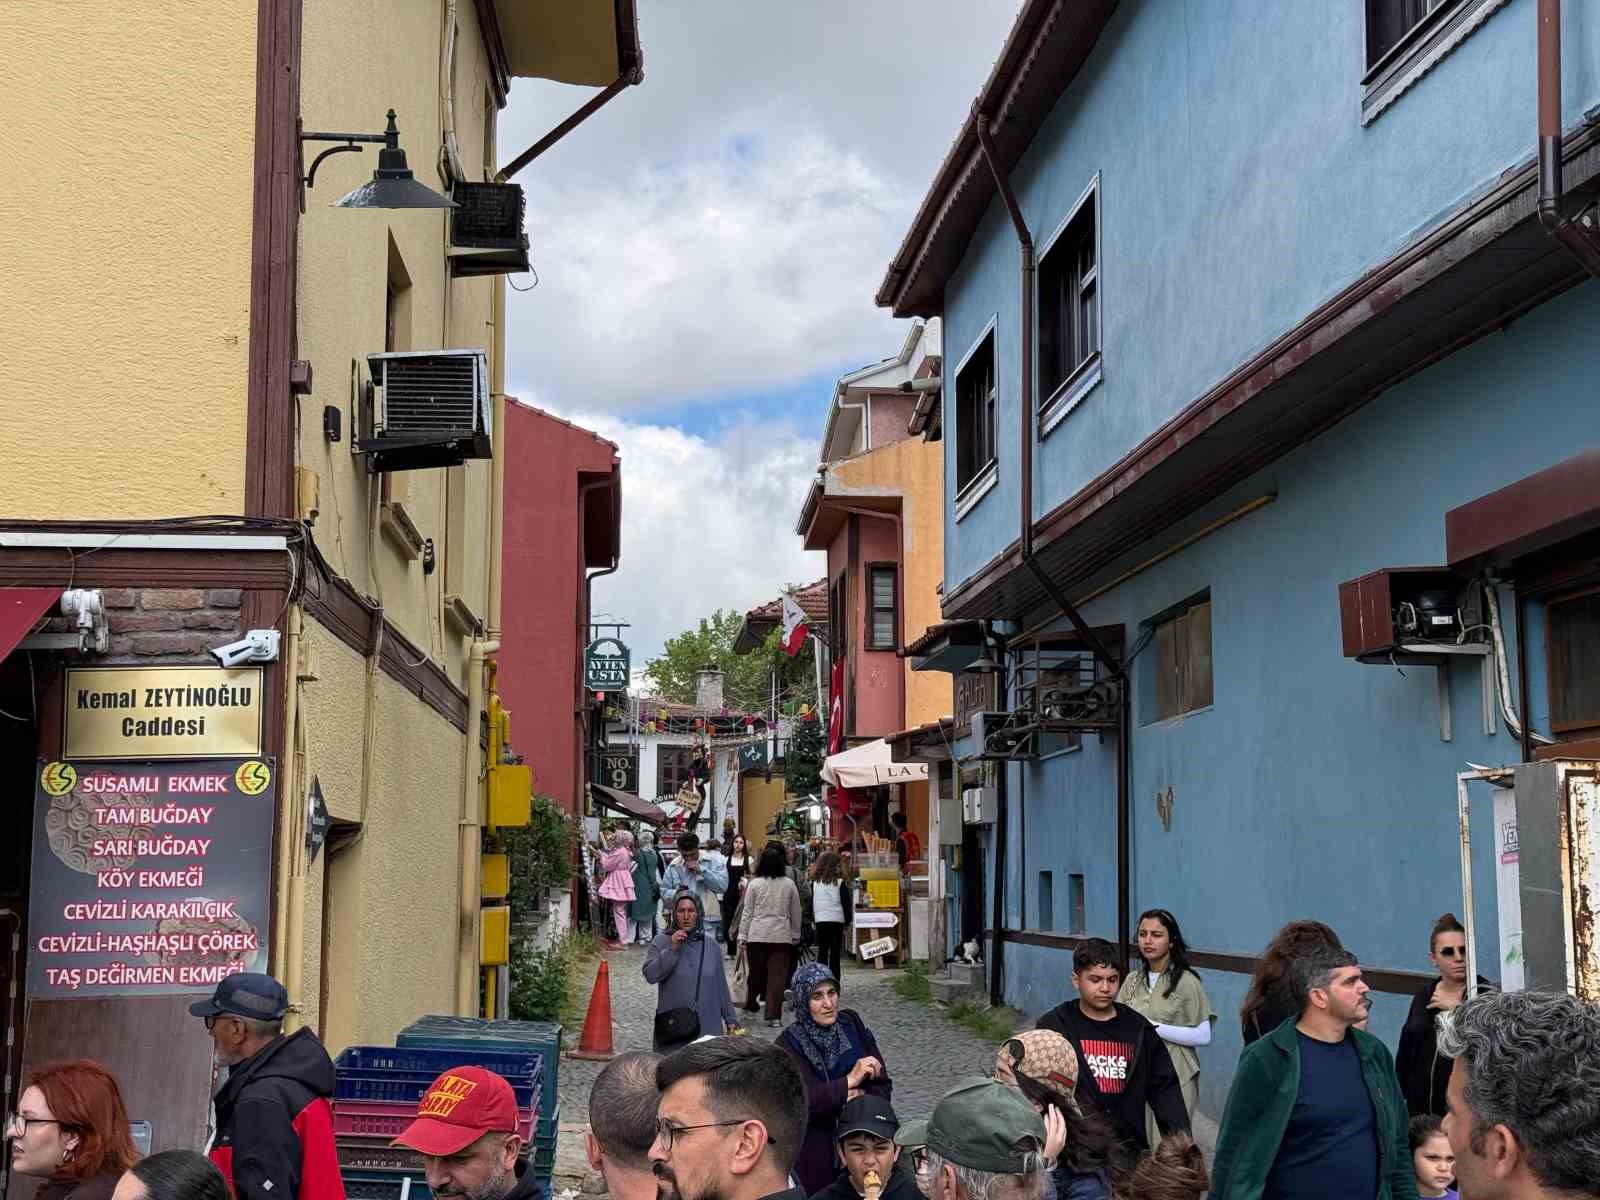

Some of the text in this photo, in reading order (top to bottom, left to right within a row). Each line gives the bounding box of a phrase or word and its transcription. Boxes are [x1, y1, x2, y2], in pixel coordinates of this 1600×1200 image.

[589, 670, 626, 681] USTA
[77, 684, 252, 709] Kemal ZEYTİNOĞLU
[121, 716, 206, 738] Caddesi
[607, 757, 632, 769] NO.
[887, 765, 912, 777] LA
[83, 776, 227, 793] SUSAMLI EKMEK
[611, 769, 628, 789] 9
[95, 803, 212, 824] TAM BUĞDAY
[94, 834, 211, 856] SARI BUĞDAY
[98, 866, 204, 888] KÖY EKMEĞİ
[63, 899, 234, 923] CEVİZLİ KARAKILÇIK
[38, 930, 256, 955] CEVİZLİ-HAŞHAŞLI ÇÖREK
[47, 968, 80, 990] TAŞ
[86, 963, 175, 985] DEĞİRMEN
[1089, 1066, 1126, 1080] ONES
